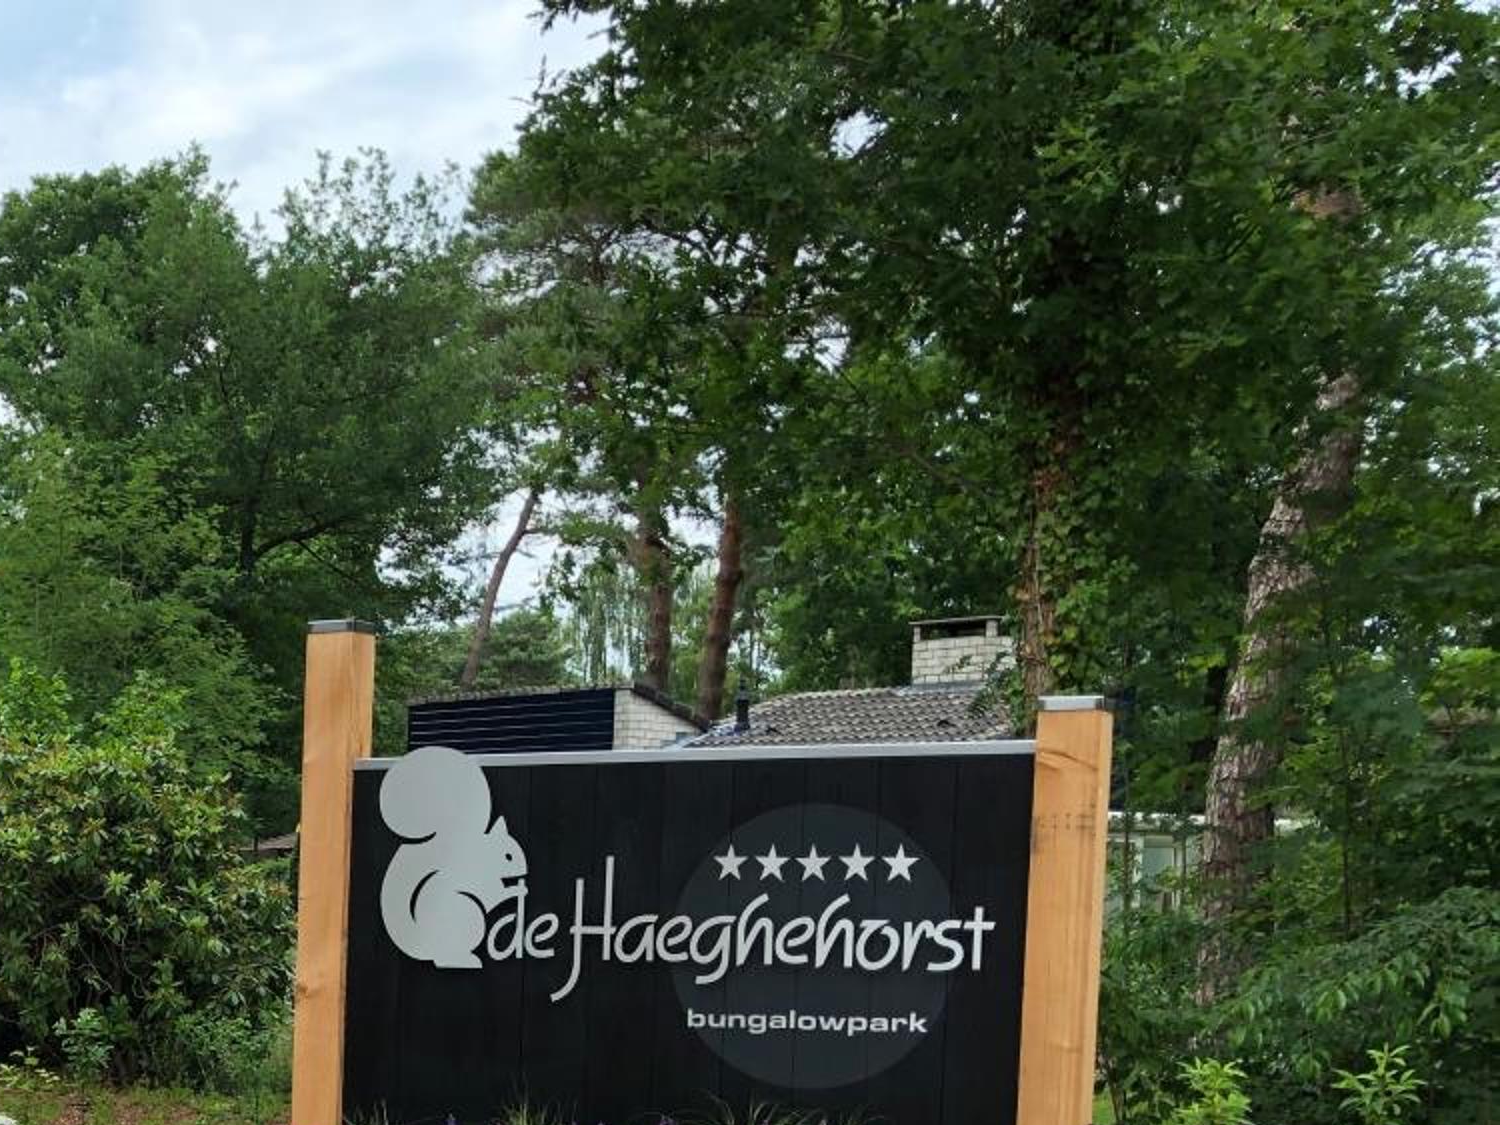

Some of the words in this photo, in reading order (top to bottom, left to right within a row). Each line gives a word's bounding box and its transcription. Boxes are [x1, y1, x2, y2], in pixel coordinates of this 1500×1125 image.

[486, 877, 560, 961] de
[549, 854, 996, 1003] Haeghehorst
[686, 1008, 928, 1037] bungalowpark
